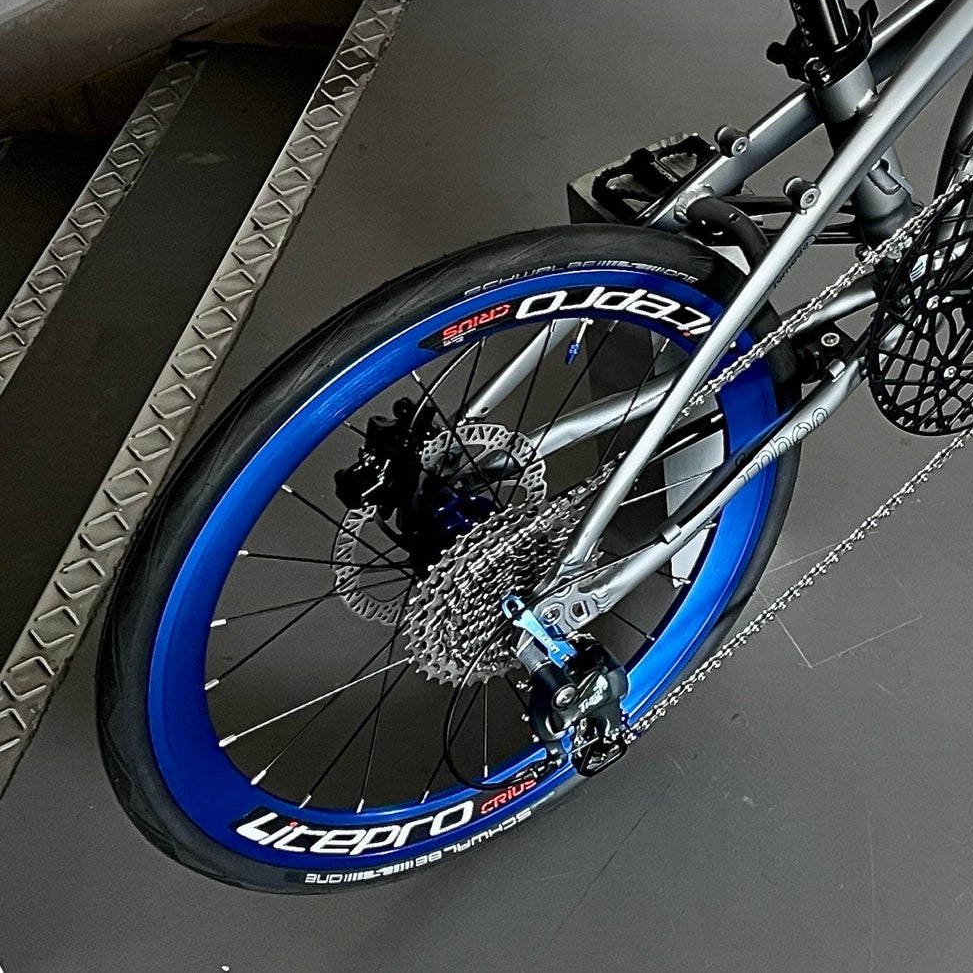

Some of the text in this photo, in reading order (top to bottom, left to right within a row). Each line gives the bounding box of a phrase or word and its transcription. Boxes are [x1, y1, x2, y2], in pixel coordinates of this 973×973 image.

[442, 286, 712, 341] itepro CRIUS
[236, 800, 474, 856] Litepro
